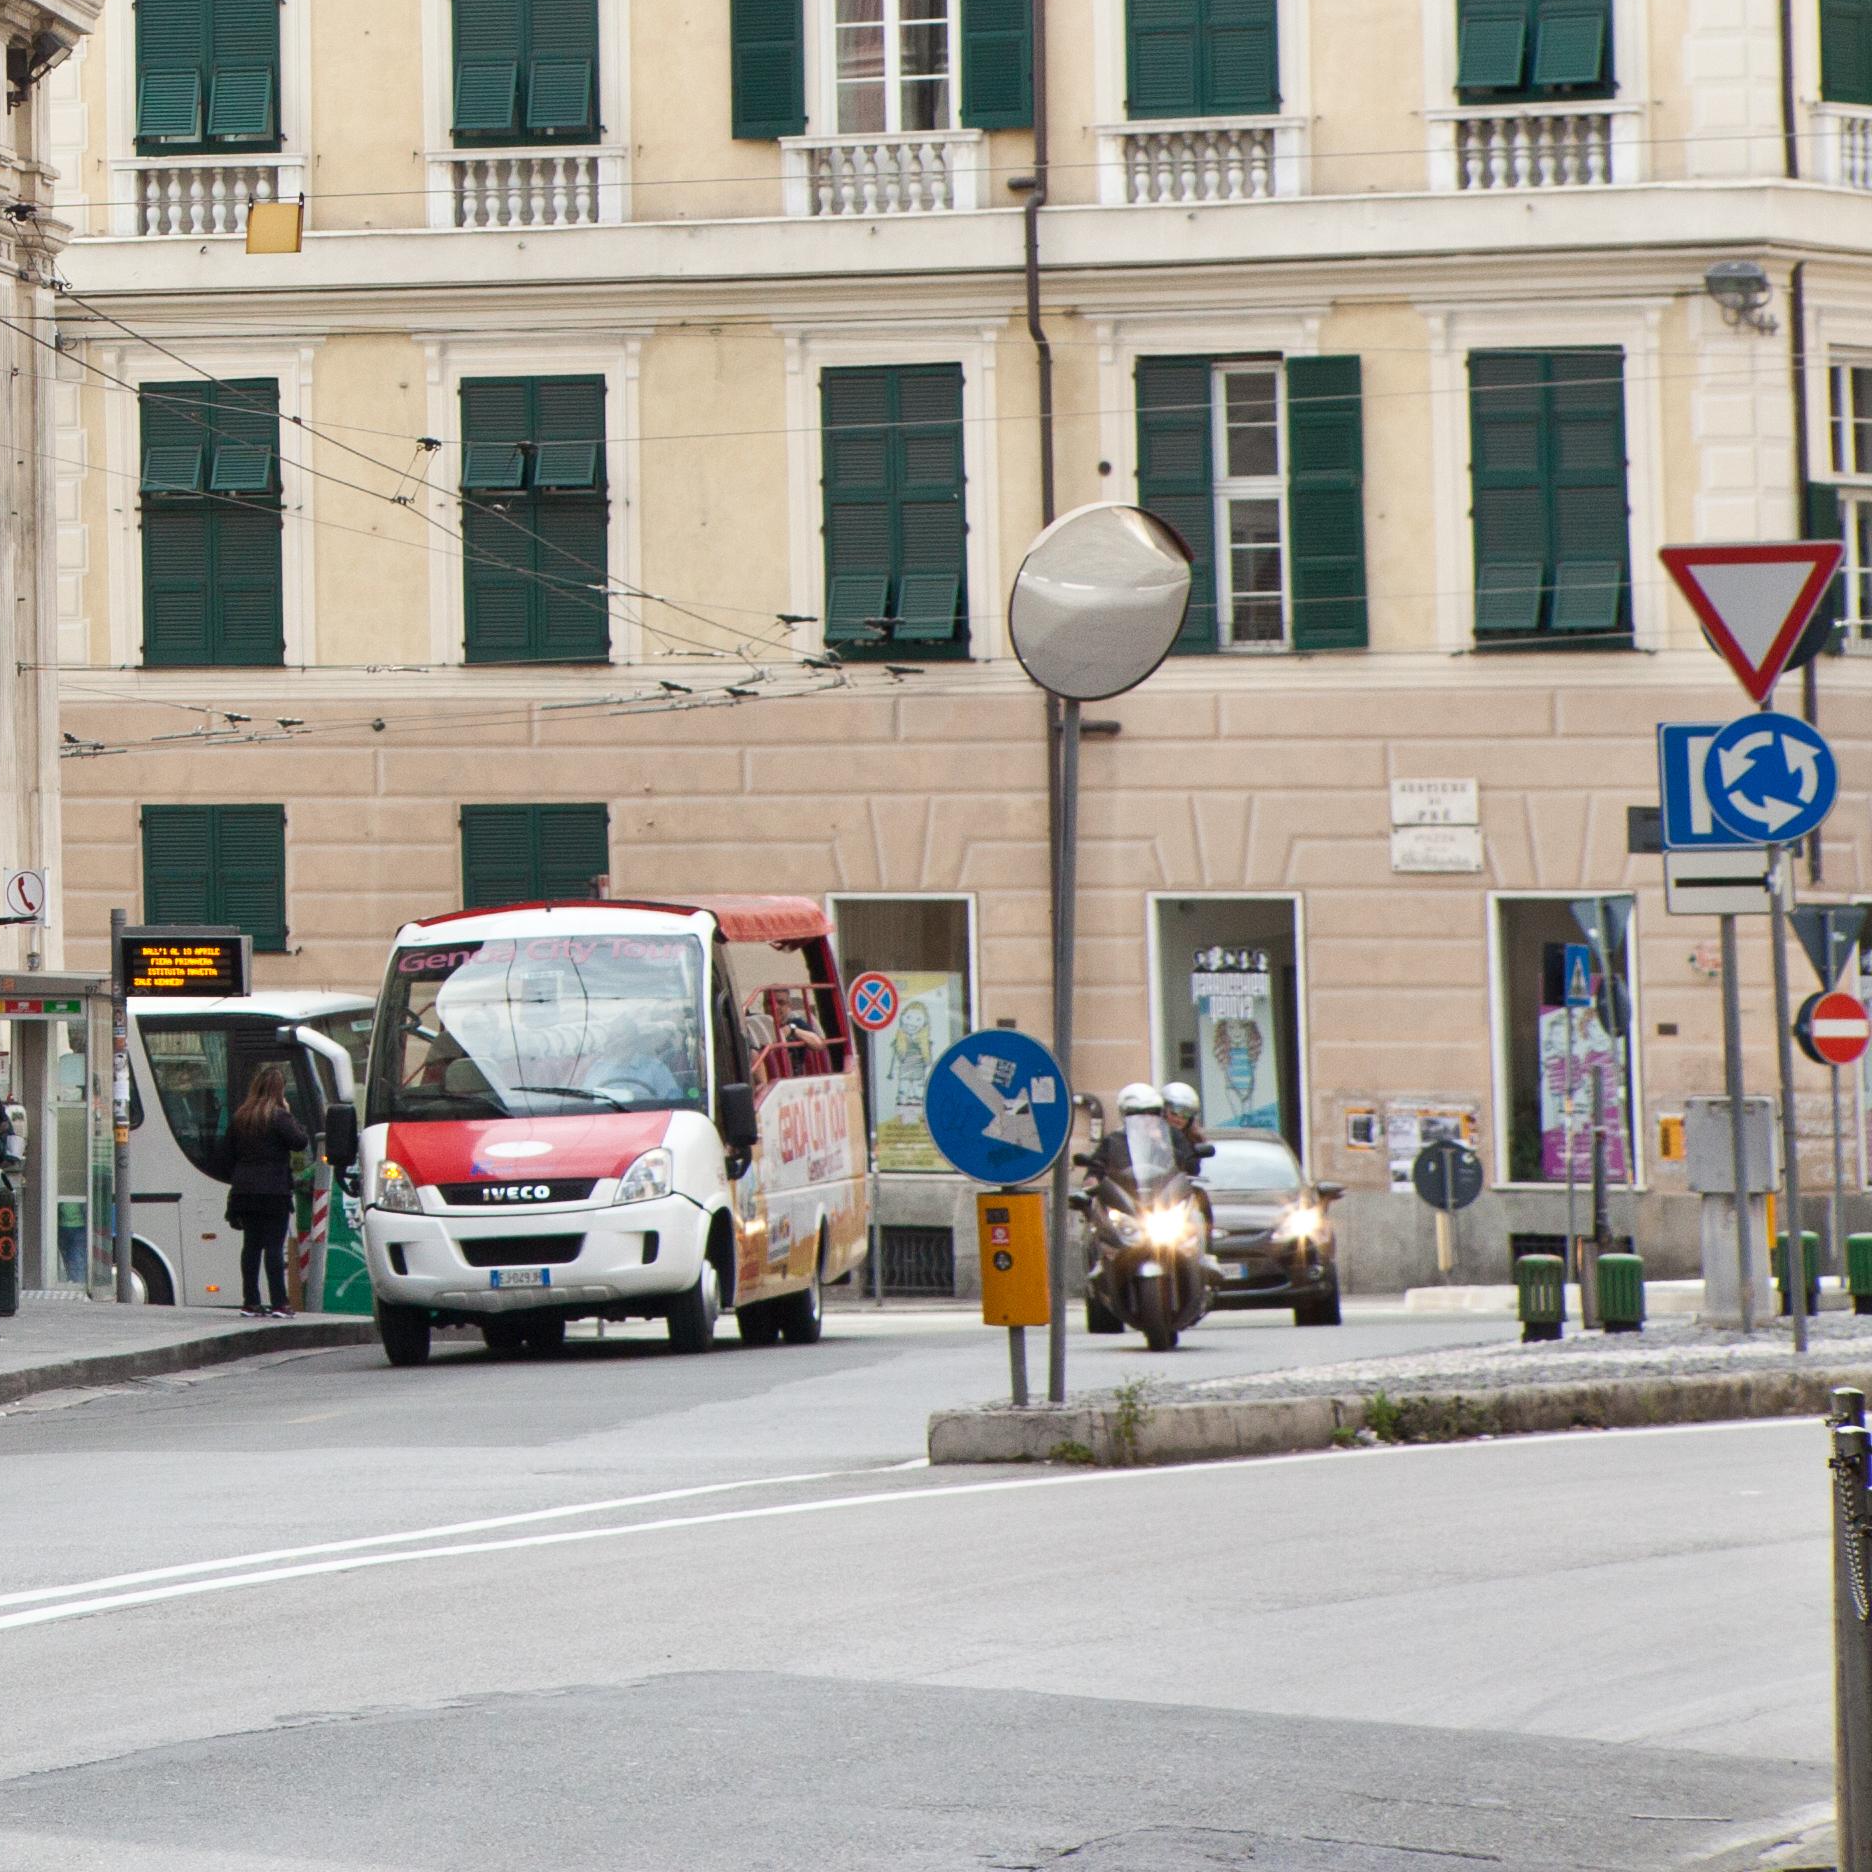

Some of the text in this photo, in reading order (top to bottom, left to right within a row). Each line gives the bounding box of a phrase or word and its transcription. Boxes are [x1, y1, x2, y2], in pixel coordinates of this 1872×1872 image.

[398, 937, 687, 973] Genoa City Tour
[482, 1185, 551, 1201] IVECO
